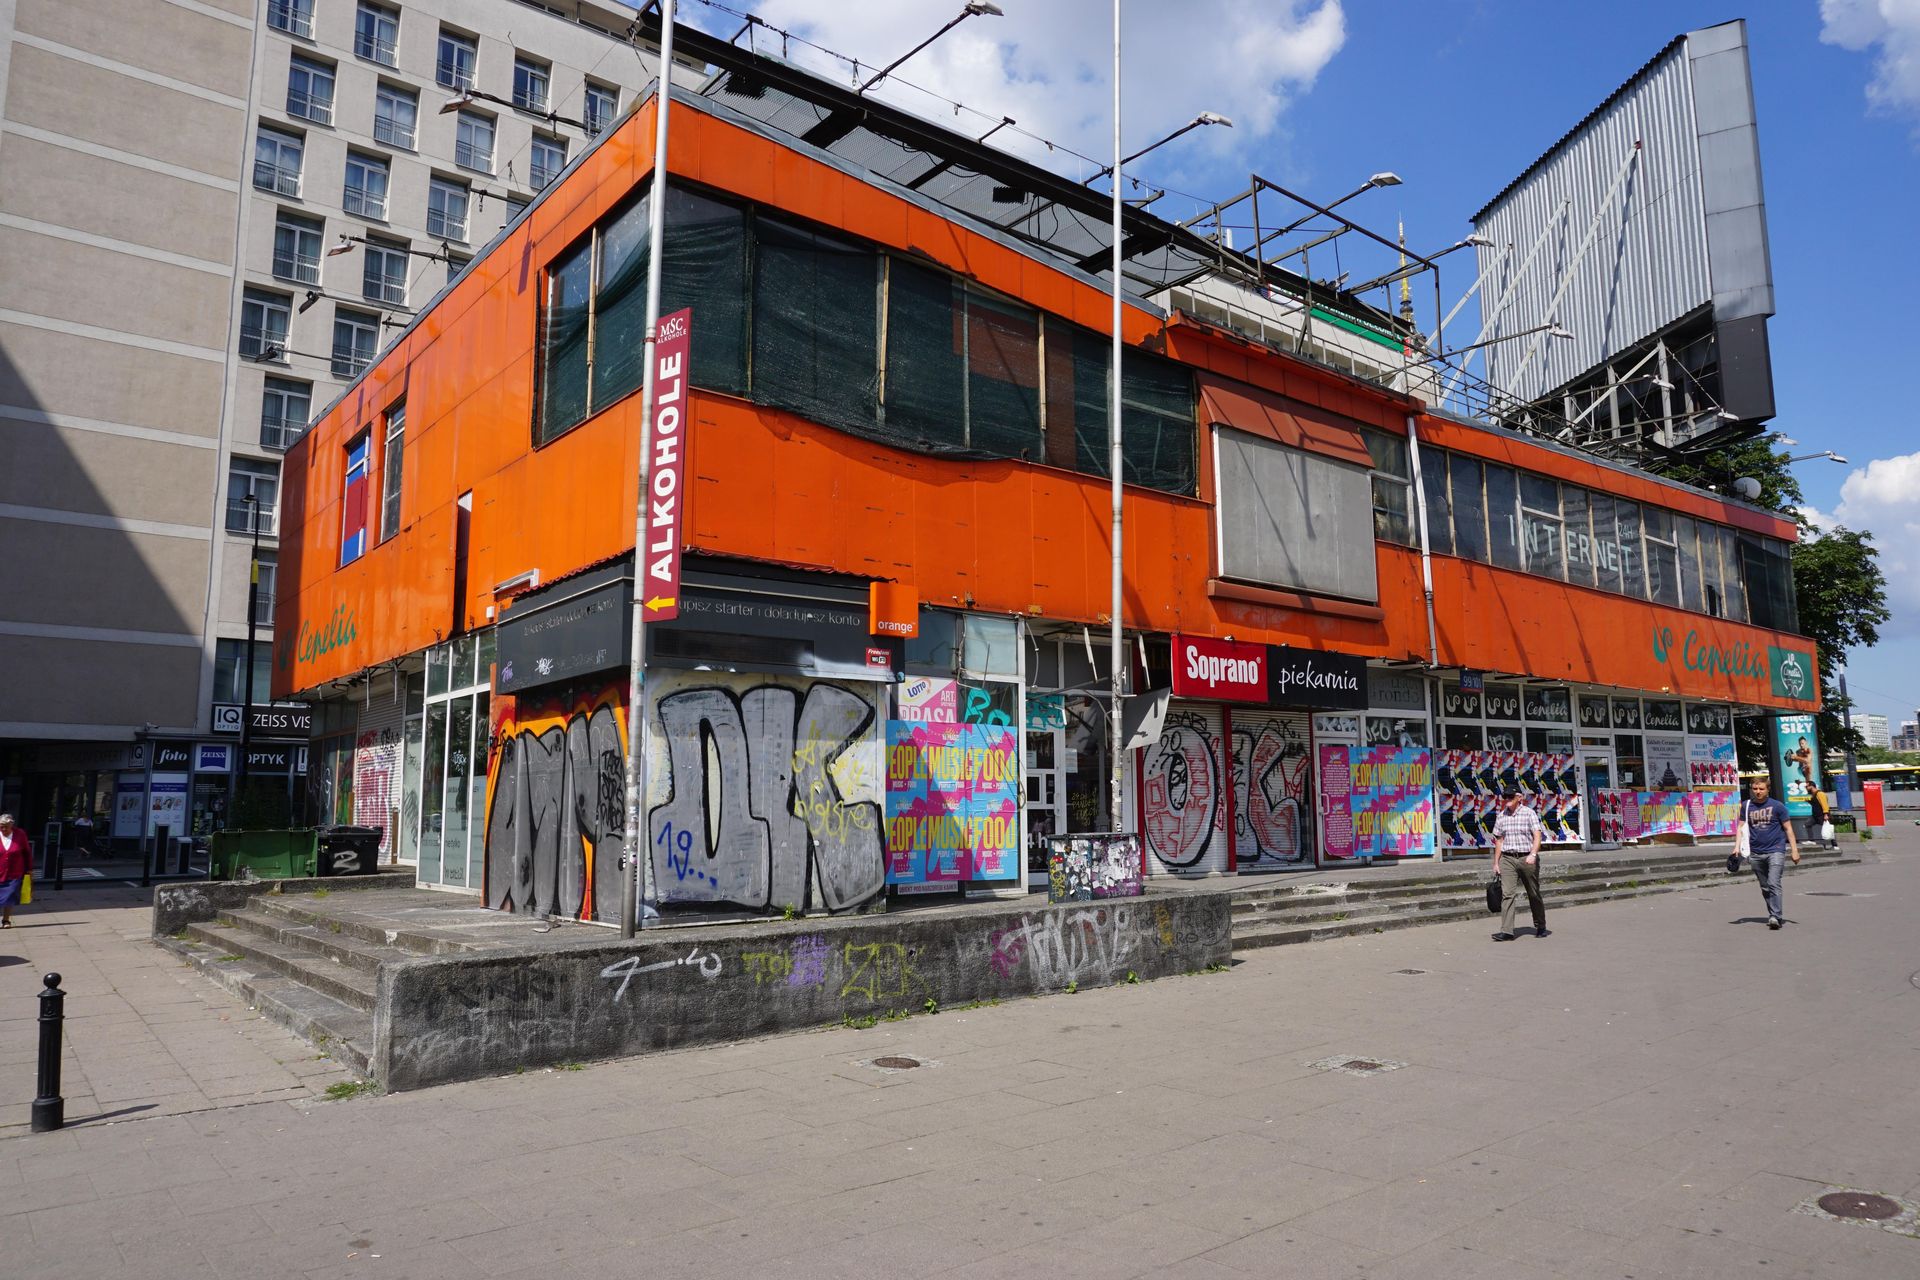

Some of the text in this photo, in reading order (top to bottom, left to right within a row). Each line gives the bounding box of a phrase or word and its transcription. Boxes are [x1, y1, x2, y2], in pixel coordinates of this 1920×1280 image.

[657, 328, 687, 344] ALKOHOLE
[660, 317, 684, 337] MSC
[651, 351, 682, 583] ALKOHOLE
[1504, 514, 1632, 575] INTERNET
[715, 602, 754, 617] starter
[828, 612, 860, 626] konto
[298, 603, 356, 665] Cepelia
[878, 621, 913, 633] orange
[1683, 630, 1766, 679] Cepelia
[1186, 645, 1259, 688] Soprano
[1278, 660, 1358, 694] piekarnia
[906, 681, 927, 698] LOTTO
[217, 709, 240, 724] IQ
[1526, 701, 1569, 717] Cepelia
[252, 713, 311, 729] ZEISS VIS
[1645, 712, 1680, 727] Cepelia
[1780, 722, 1813, 734] SIŁY
[131, 746, 145, 760] IQ
[158, 748, 188, 765] foto
[928, 745, 972, 781] MUSIC
[973, 747, 1016, 782] FOOD
[928, 815, 972, 850] MUSIC
[973, 815, 1016, 849] FOOD
